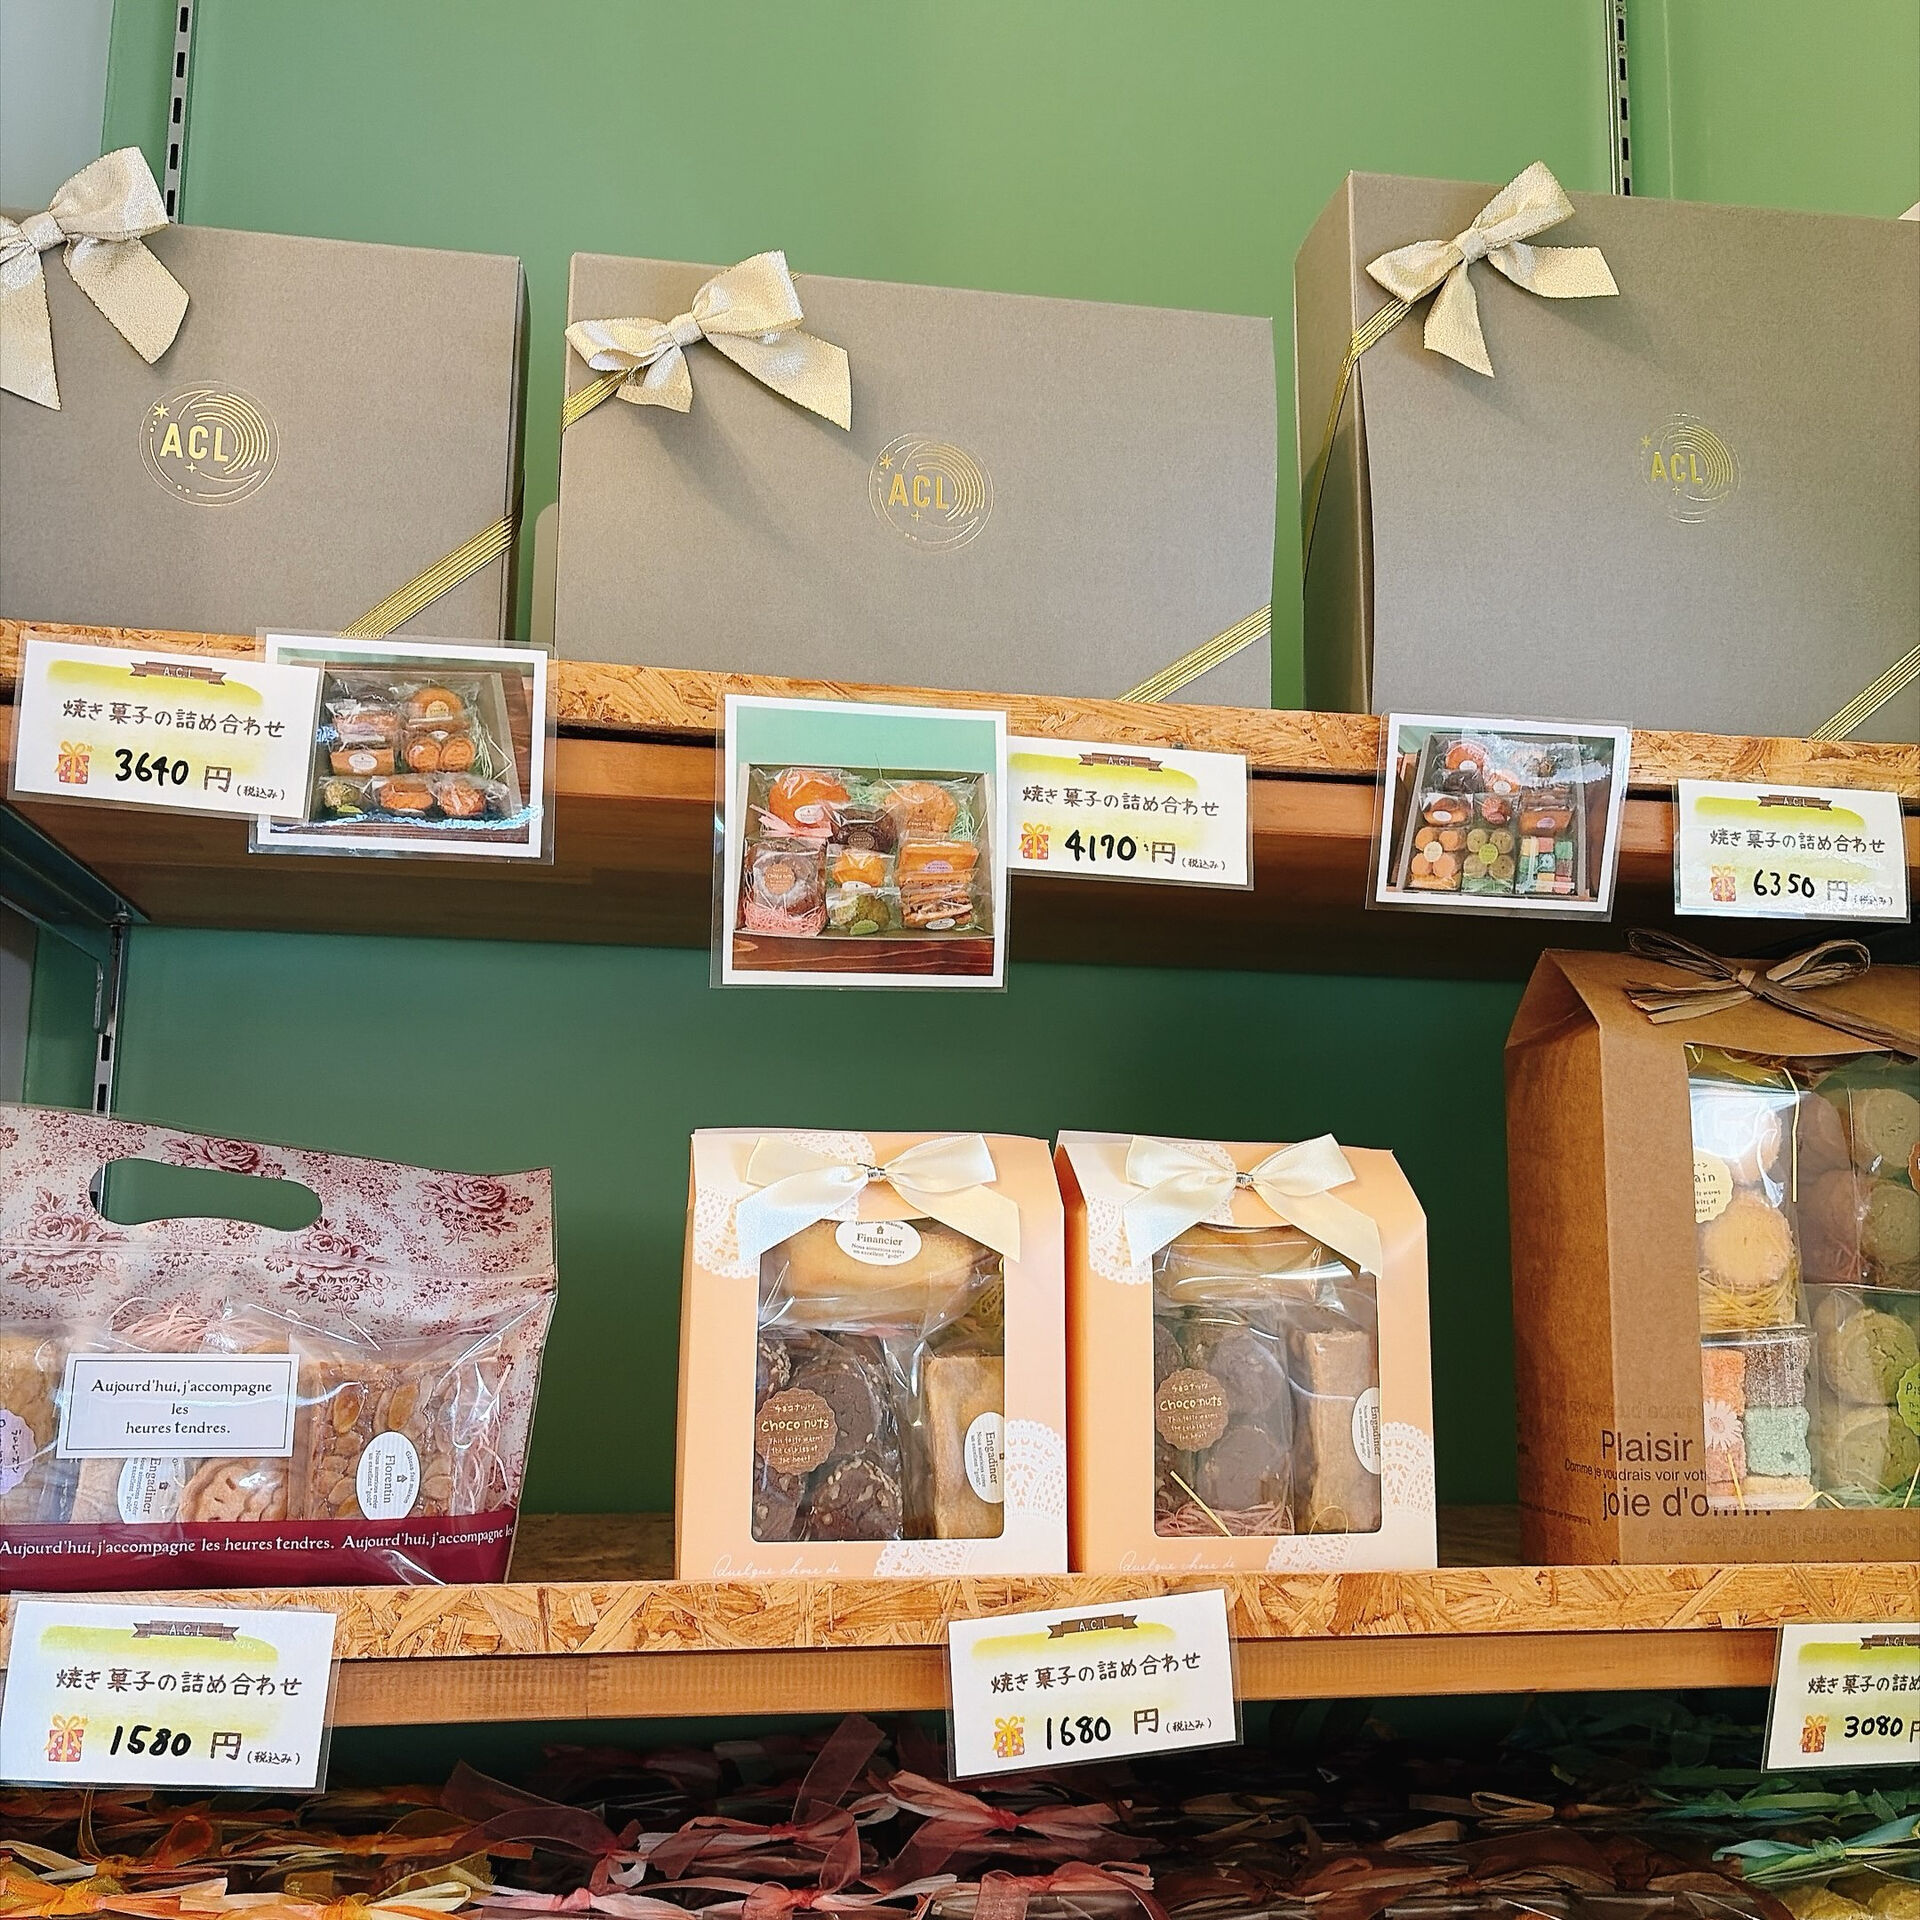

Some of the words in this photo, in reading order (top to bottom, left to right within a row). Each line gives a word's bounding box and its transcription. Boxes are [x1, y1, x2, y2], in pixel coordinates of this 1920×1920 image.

[160, 422, 229, 462] ACL
[1650, 451, 1704, 485] ACL
[888, 473, 949, 510] ACL
[114, 749, 189, 786] 3640
[203, 765, 232, 793] 円
[1064, 829, 1136, 862] 4170
[1151, 841, 1176, 865] 円
[1753, 869, 1815, 898] 6350
[1827, 880, 1848, 902] 円
[857, 1233, 903, 1246] Financier
[181, 1379, 272, 1397] j'accompagne
[171, 1403, 189, 1415] les
[126, 1421, 171, 1435] heures
[175, 1421, 231, 1435] tendres.
[985, 1432, 998, 1484] Engadiner
[1601, 1430, 1693, 1462] Plaisir
[143, 1458, 162, 1515] Engadiner
[383, 1455, 396, 1504] Florentin
[1565, 1457, 1593, 1476] Comme
[1602, 1467, 1651, 1482] voudrais
[1655, 1468, 1679, 1481] voir
[1602, 1484, 1650, 1521] joie
[96, 1540, 196, 1558] j'accompagne
[201, 1538, 220, 1552] les
[224, 1538, 273, 1551] heures
[275, 1536, 335, 1551] tendres.
[110, 1725, 191, 1756] 1580
[210, 1731, 242, 1760] 円
[1046, 1716, 1111, 1750] 1680
[1133, 1707, 1159, 1735] 円
[1844, 1715, 1903, 1738] 3080
